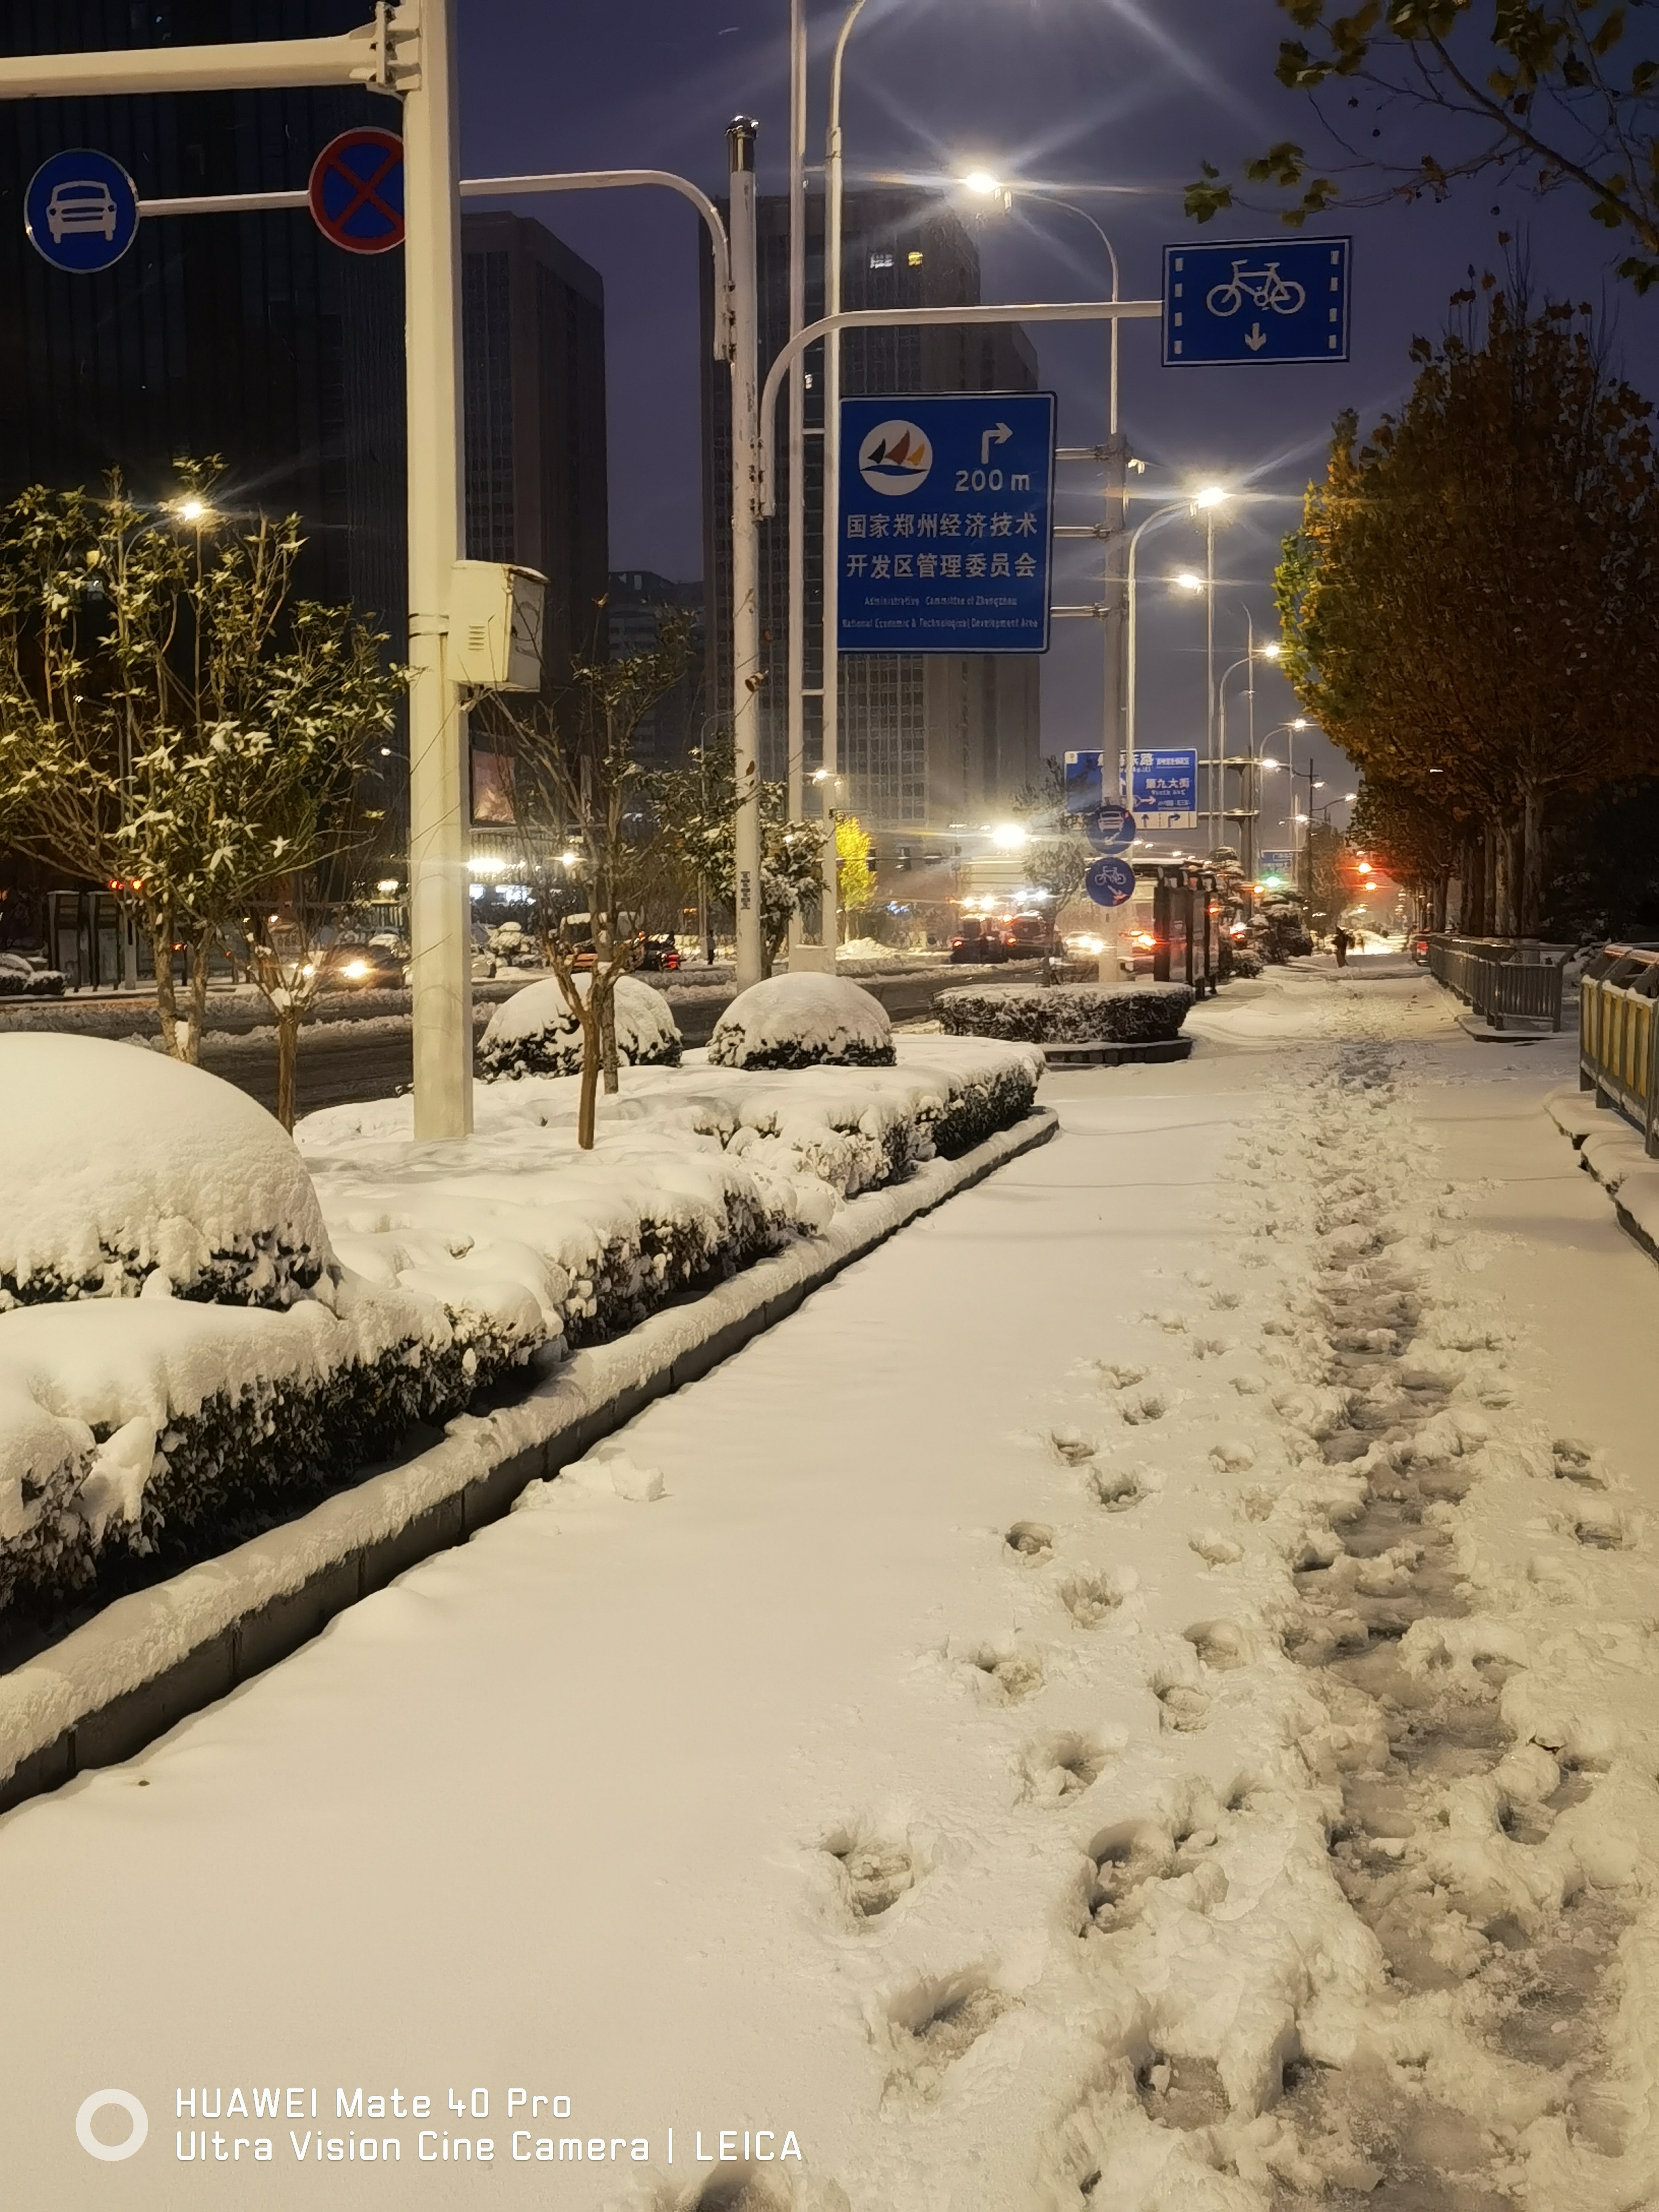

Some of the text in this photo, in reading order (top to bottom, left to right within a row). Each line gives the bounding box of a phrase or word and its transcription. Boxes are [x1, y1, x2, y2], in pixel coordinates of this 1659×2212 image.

[955, 469, 1030, 492] 200 m
[846, 512, 1038, 538] 国家郑州经济技术
[846, 552, 1037, 579] 开发区管理委员会
